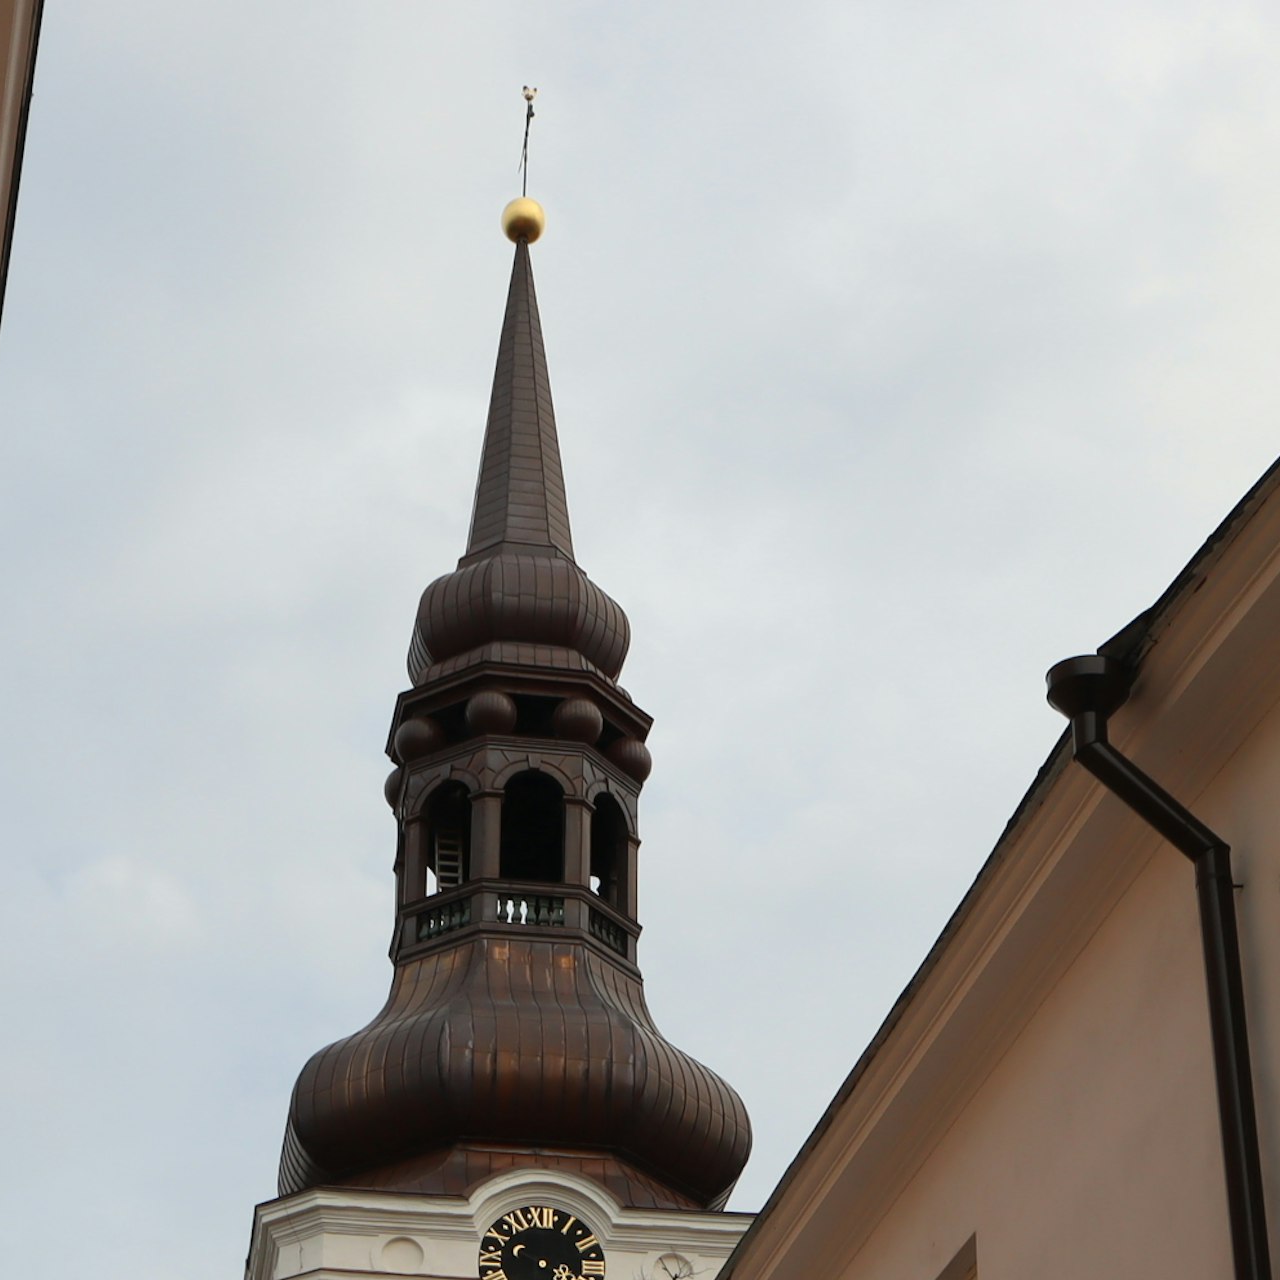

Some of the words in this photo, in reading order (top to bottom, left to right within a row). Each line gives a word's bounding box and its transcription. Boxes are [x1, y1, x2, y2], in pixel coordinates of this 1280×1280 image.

[503, 1209, 531, 1235] XI
[529, 1207, 555, 1229] XII
[561, 1216, 578, 1235] I
[485, 1228, 510, 1247] X
[575, 1234, 599, 1253] II
[480, 1249, 502, 1267] IX
[581, 1260, 605, 1276] III
